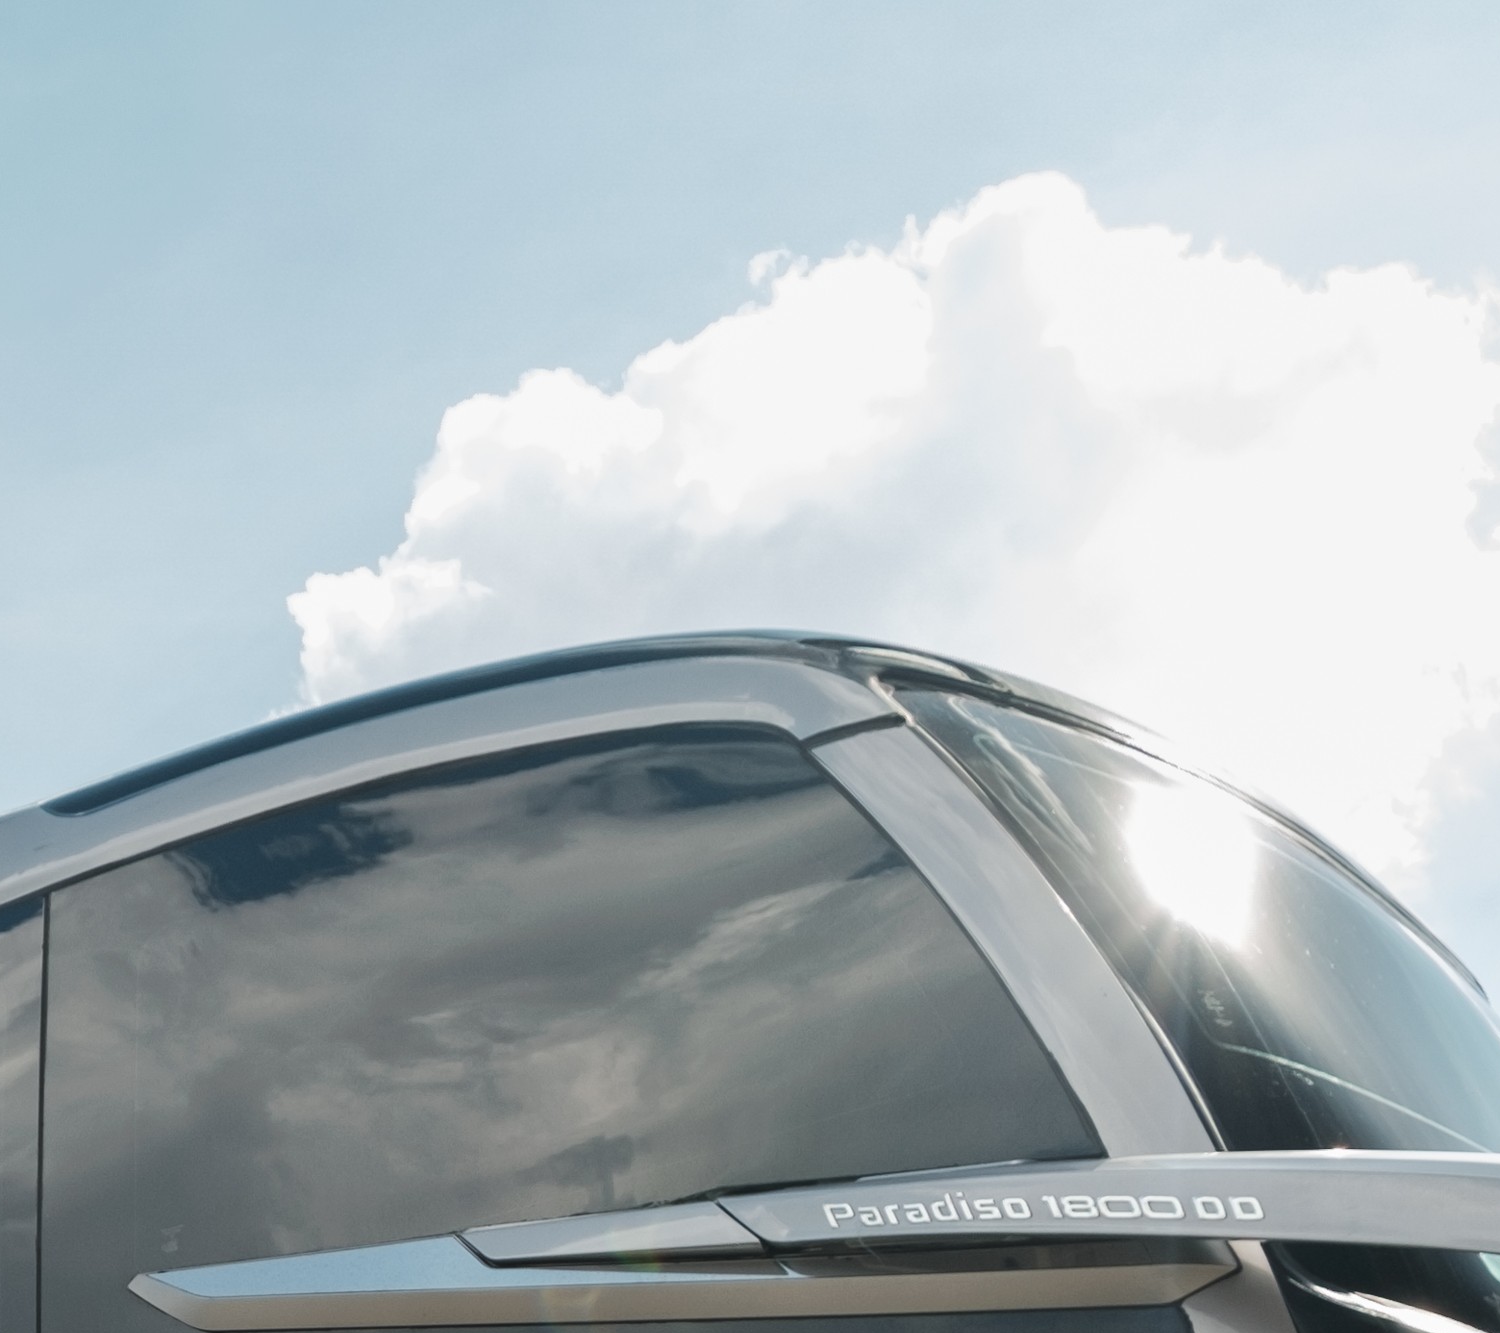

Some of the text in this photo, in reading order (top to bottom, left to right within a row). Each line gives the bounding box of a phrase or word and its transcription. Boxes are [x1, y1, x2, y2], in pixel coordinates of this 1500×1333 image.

[821, 1191, 1266, 1229] Paradiso 1800 DD
